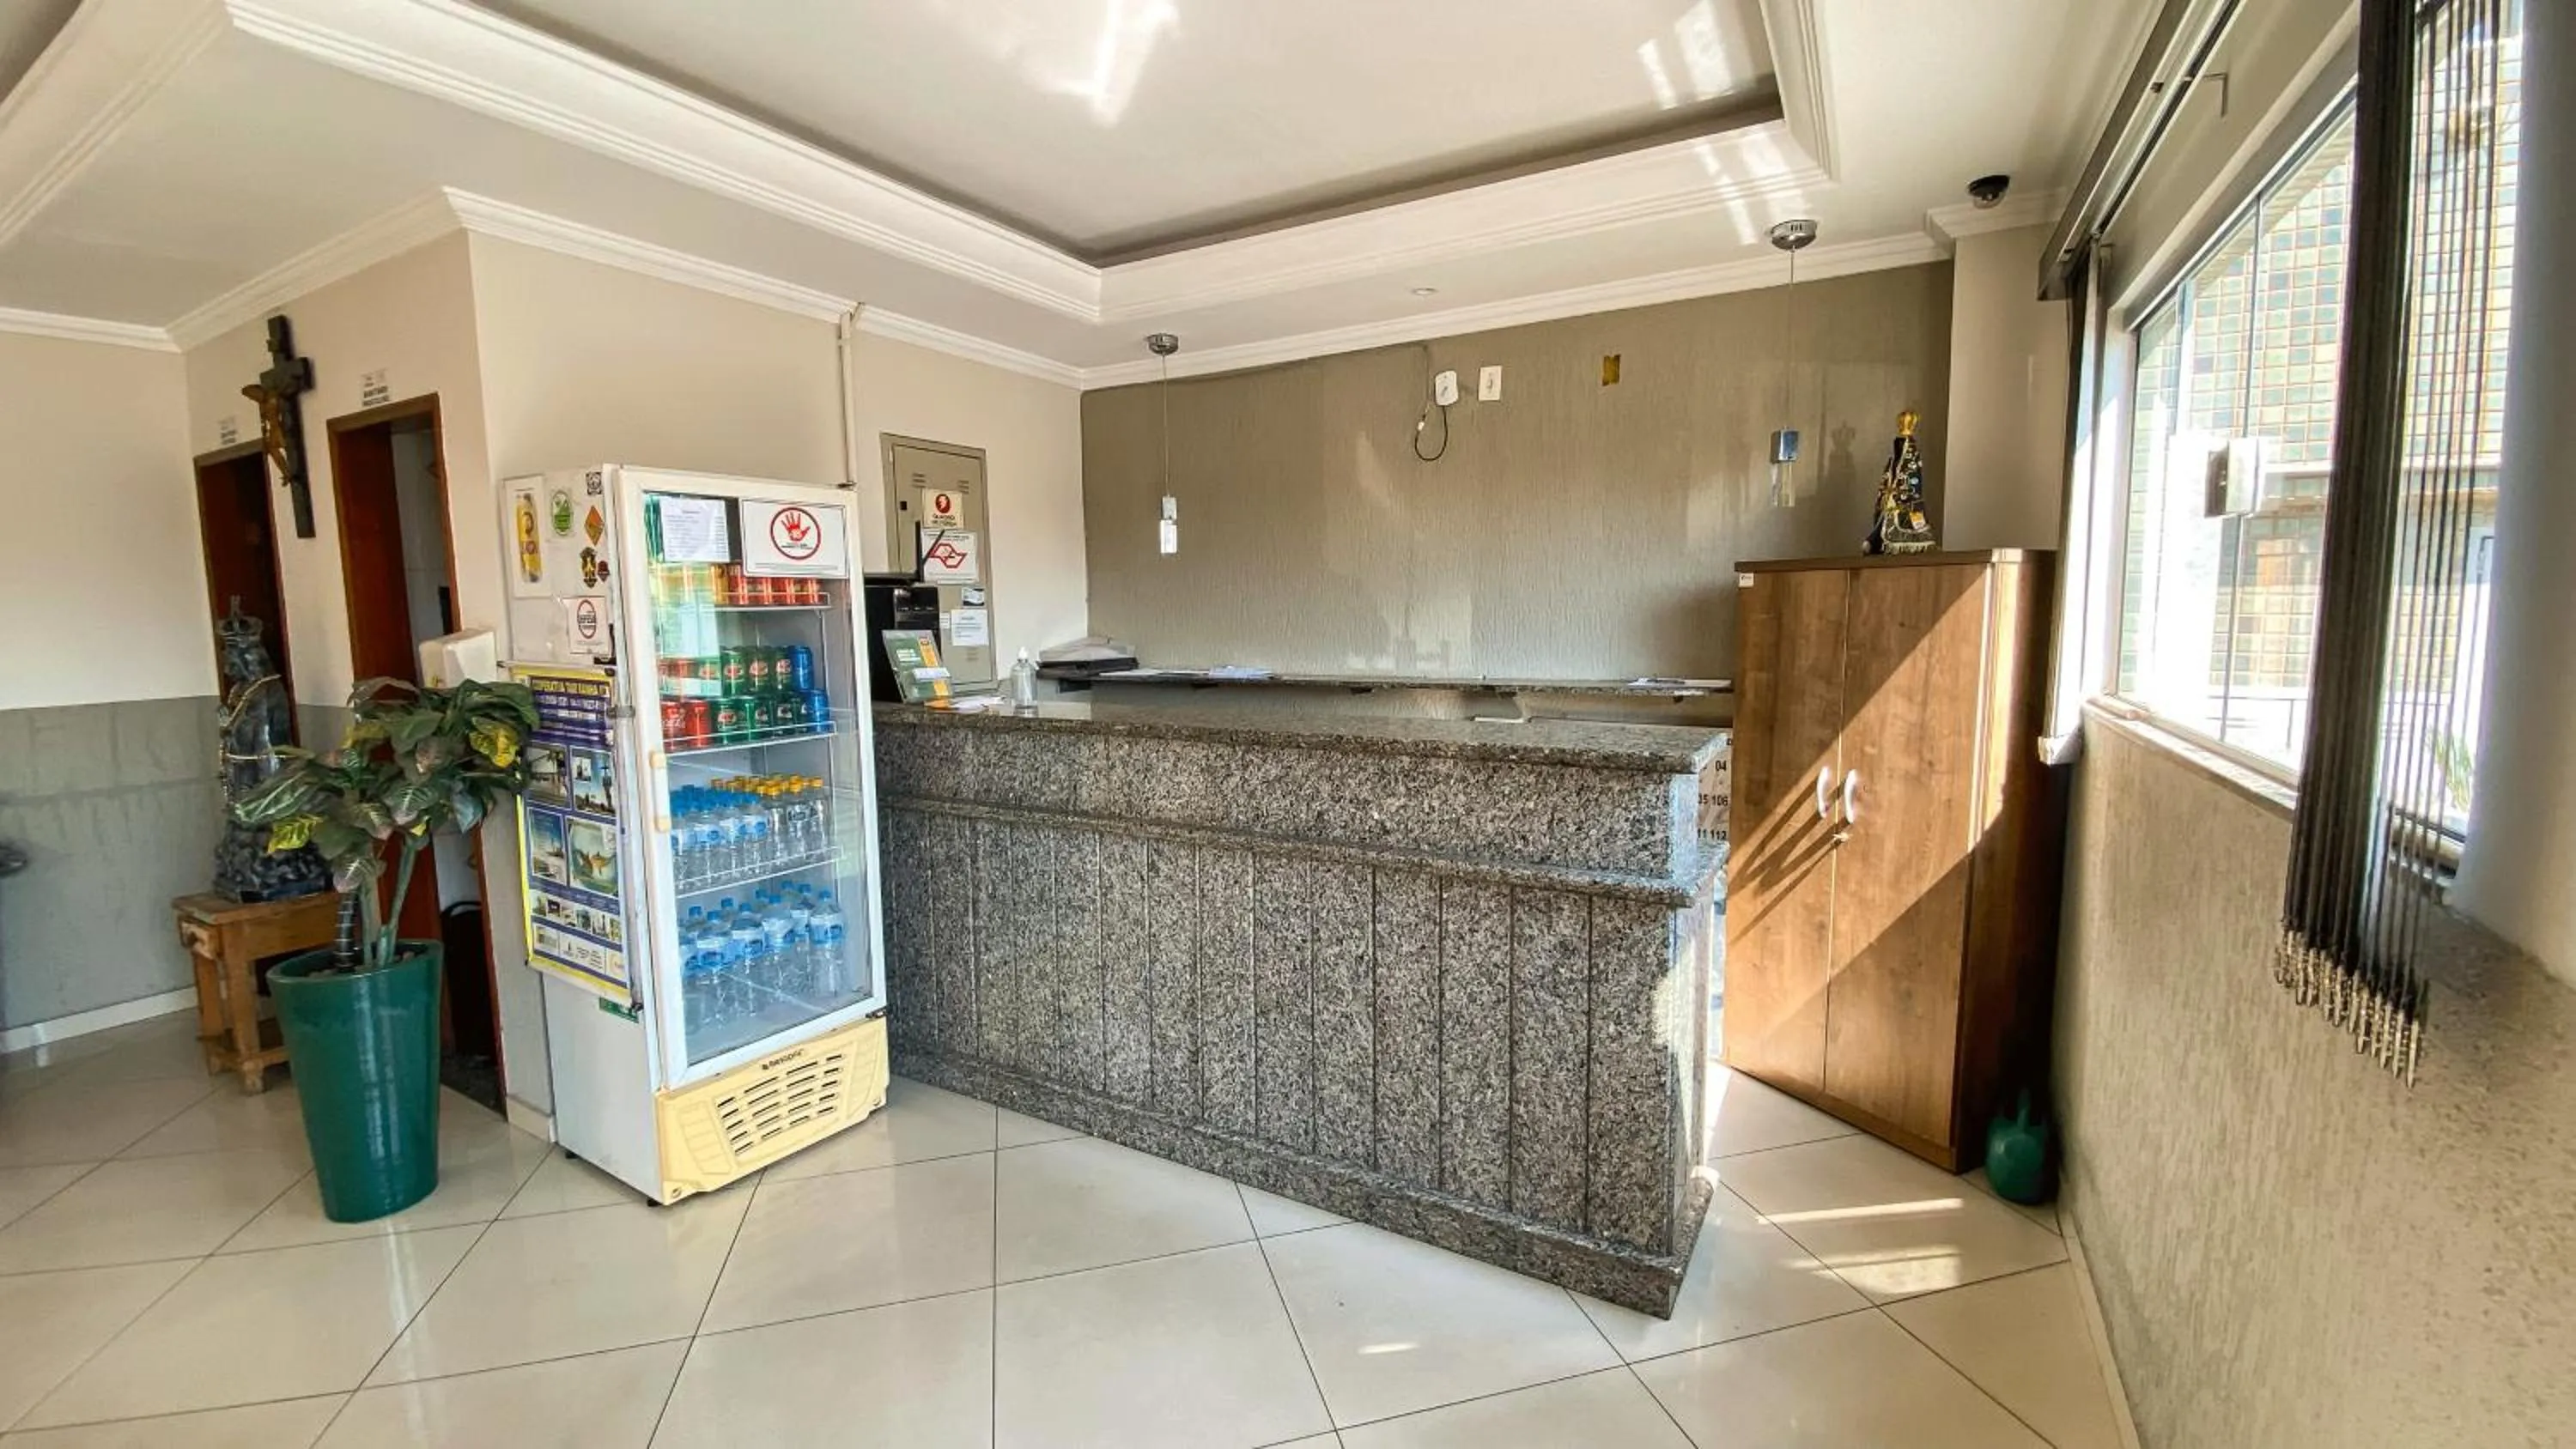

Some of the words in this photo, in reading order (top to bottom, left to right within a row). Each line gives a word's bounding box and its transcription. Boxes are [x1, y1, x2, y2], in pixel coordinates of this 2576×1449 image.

[1715, 760, 1727, 772] 04
[1712, 795, 1728, 806] 106
[1710, 829, 1727, 840] 112
